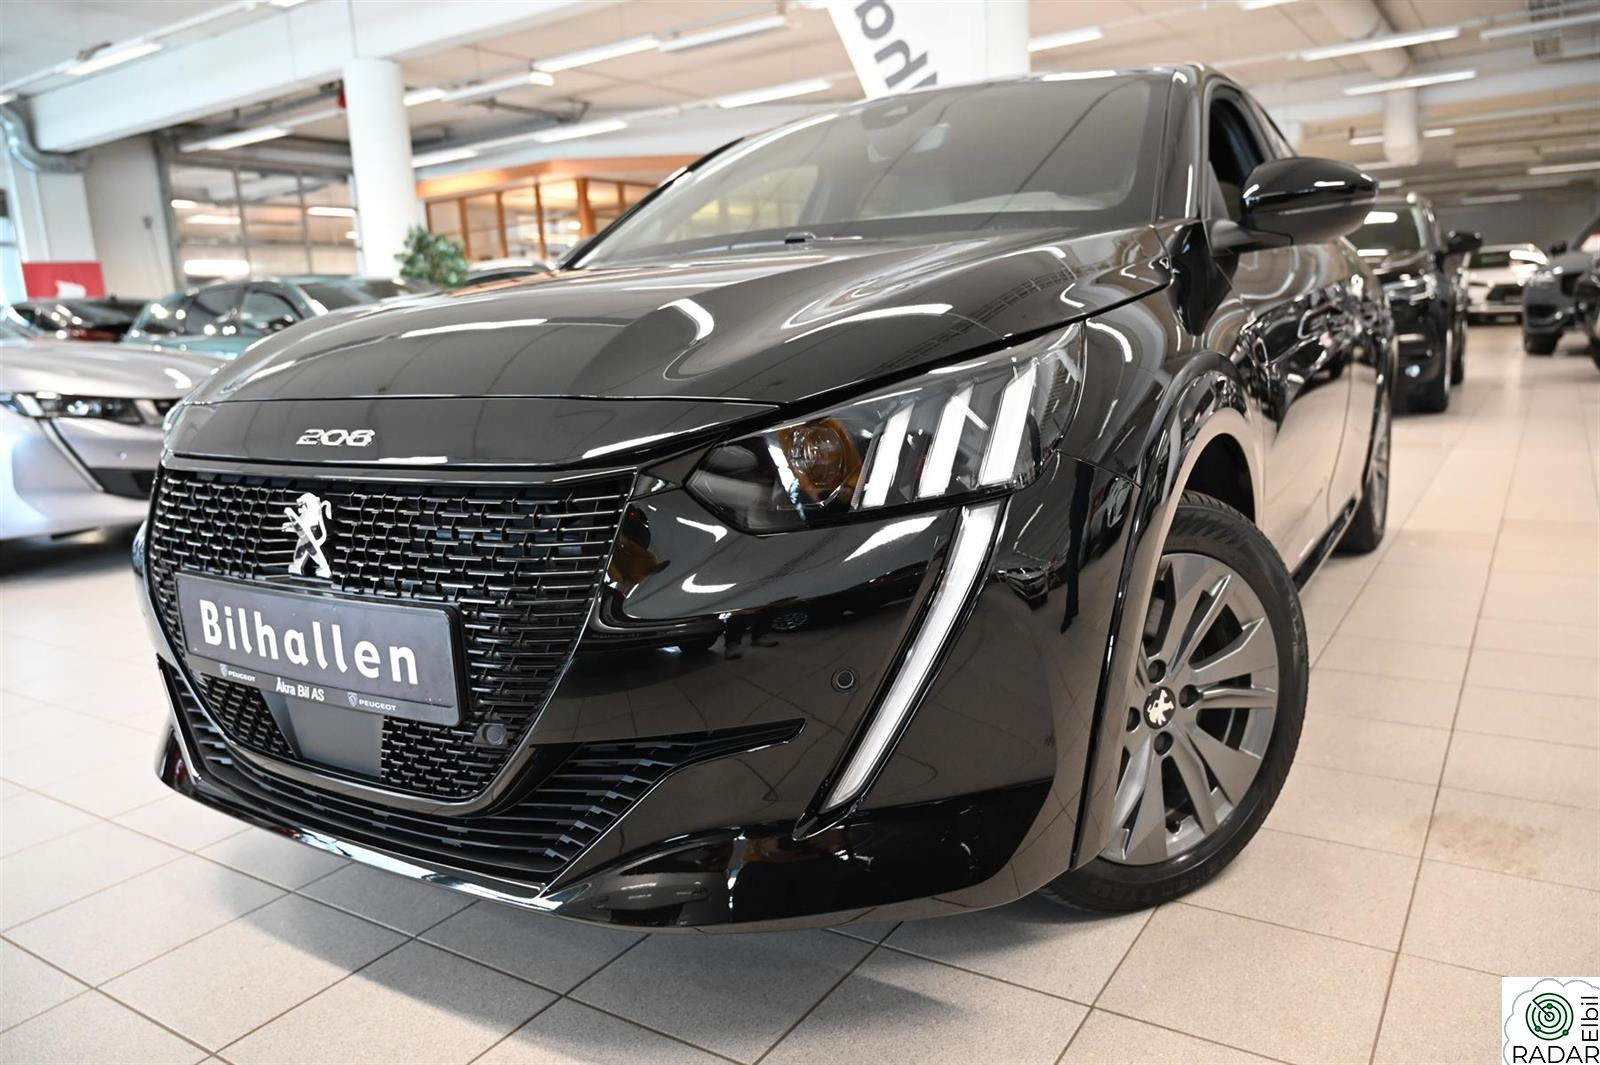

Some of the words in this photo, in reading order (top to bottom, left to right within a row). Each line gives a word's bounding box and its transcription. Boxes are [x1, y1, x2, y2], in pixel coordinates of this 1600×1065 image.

[296, 428, 376, 447] 208
[199, 599, 418, 685] Bilhallen
[228, 670, 256, 682] PEUGEOT
[276, 676, 296, 697] Åkra
[297, 684, 310, 699] Bil
[311, 687, 325, 702] AS
[359, 698, 397, 711] PEUGEOT
